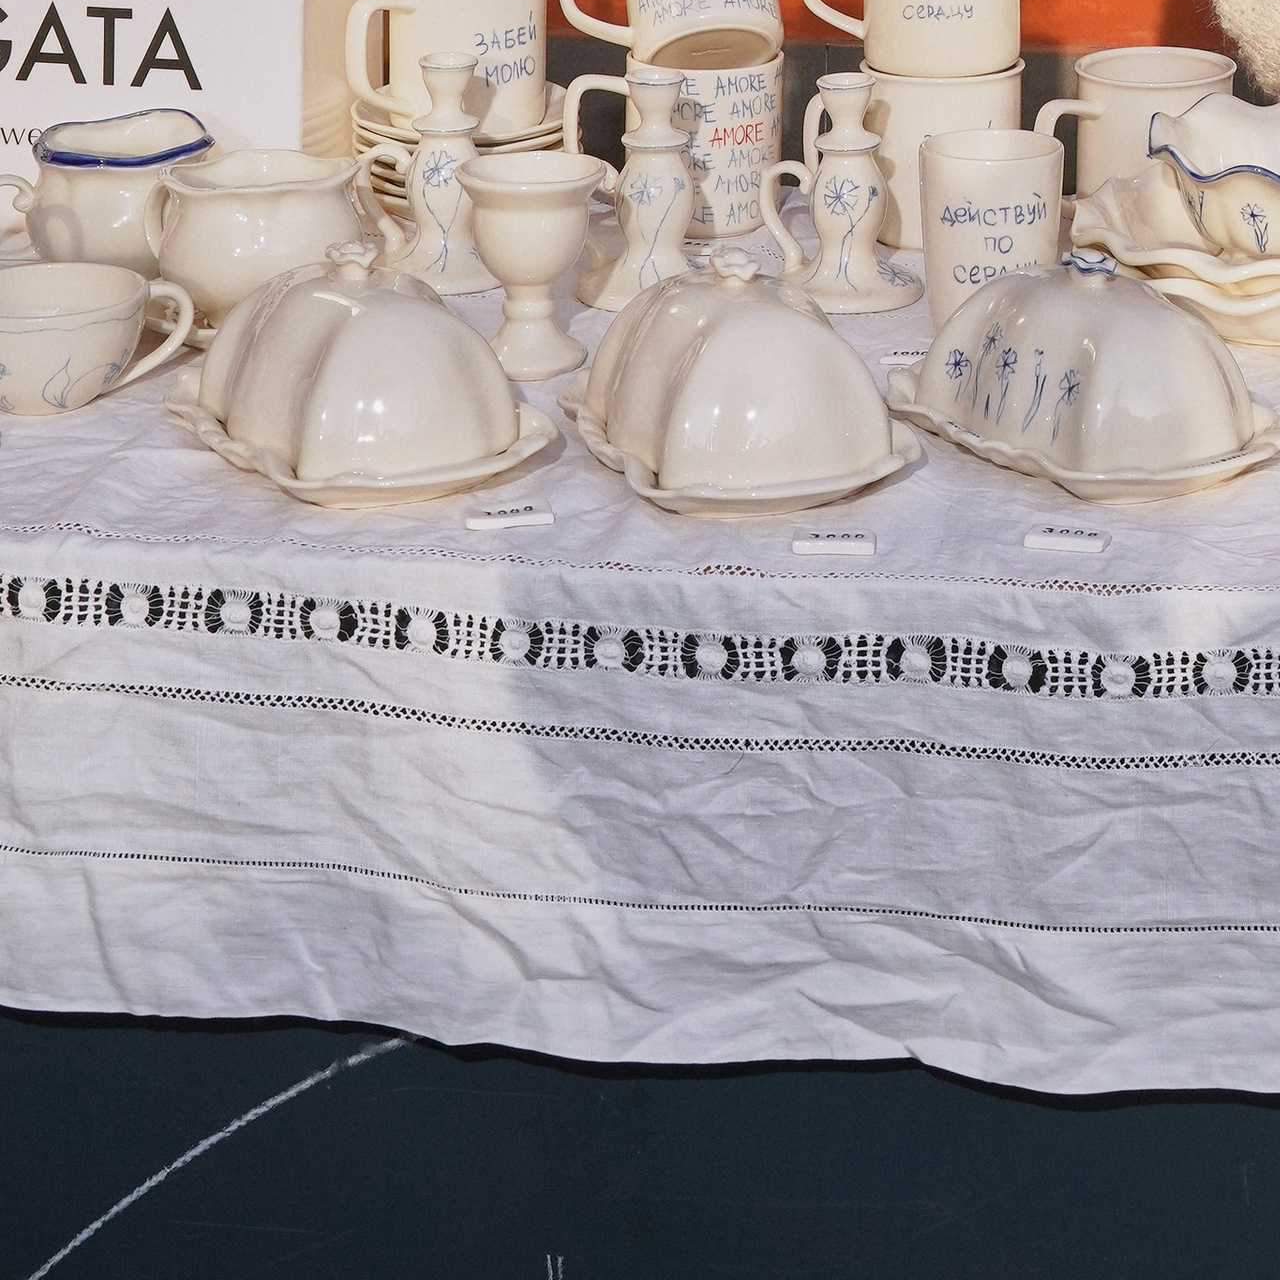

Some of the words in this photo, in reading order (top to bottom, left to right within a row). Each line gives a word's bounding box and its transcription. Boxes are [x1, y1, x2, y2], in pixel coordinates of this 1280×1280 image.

[474, 10, 537, 56] ЗАБЕЙ
[484, 55, 536, 88] МОЛЮ
[714, 73, 767, 99] AMORE
[673, 102, 716, 123] ORE
[729, 93, 777, 121] AMORE
[709, 122, 764, 149] AMORE
[680, 149, 716, 171] ORE
[727, 144, 775, 169] AMORE
[714, 171, 760, 195] AMOR
[726, 199, 760, 227] AMO
